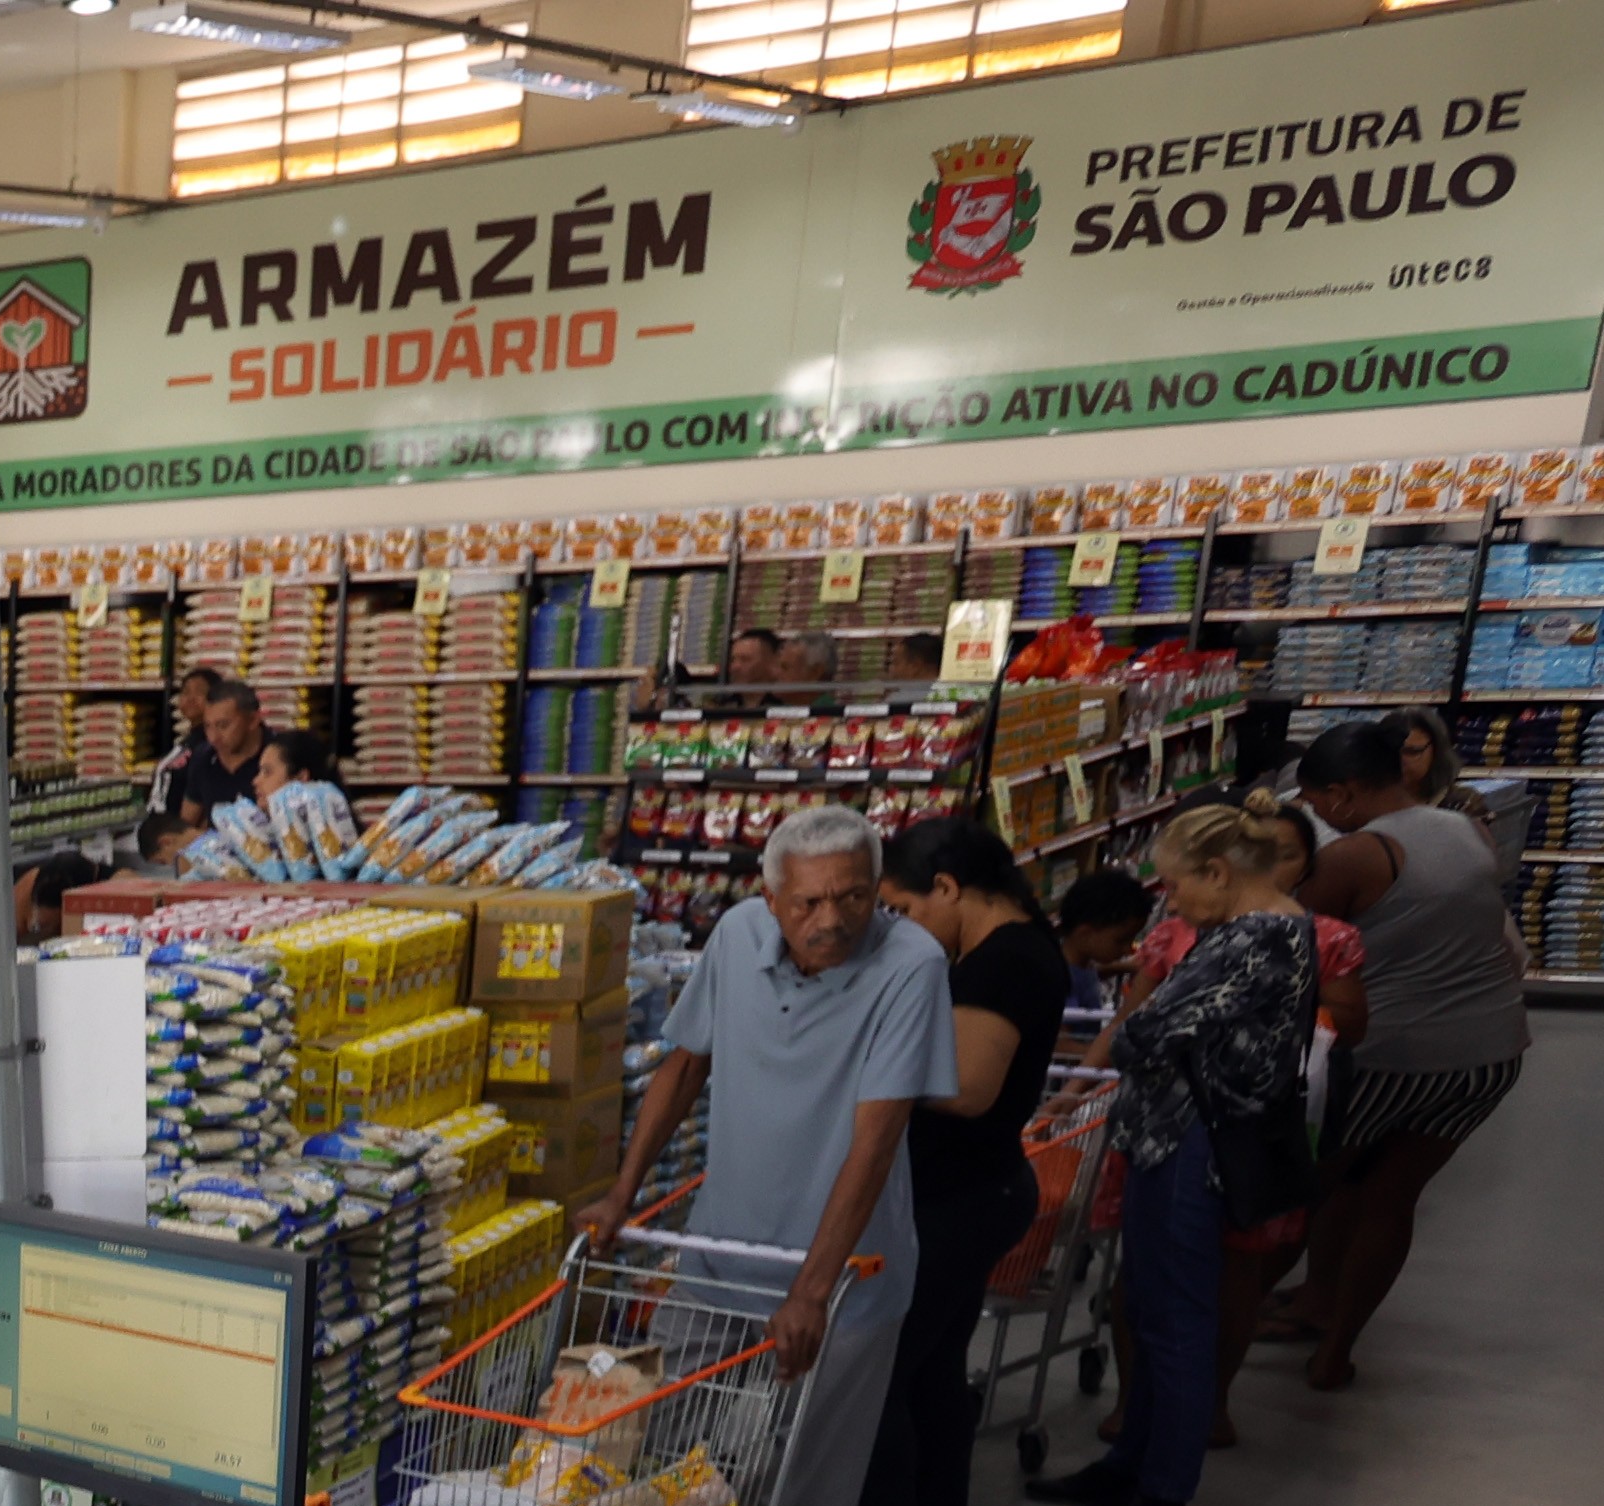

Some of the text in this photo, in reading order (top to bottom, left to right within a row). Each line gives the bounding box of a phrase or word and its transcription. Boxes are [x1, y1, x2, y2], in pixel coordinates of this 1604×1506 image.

[1085, 89, 1528, 189] PREFEITURA DE
[1069, 151, 1519, 258] SÃO PAULO
[167, 186, 713, 337] ARMAZÉM
[229, 306, 619, 403] SOLIDÁRIO
[14, 457, 201, 500] MORADORES
[212, 454, 255, 486] DA
[265, 444, 389, 480] CIDADE
[396, 437, 439, 469] DE
[662, 411, 749, 451] COM
[1001, 376, 1132, 424] ATIVA
[1148, 367, 1220, 411] NO
[1233, 344, 1511, 403] CADÚNICO
